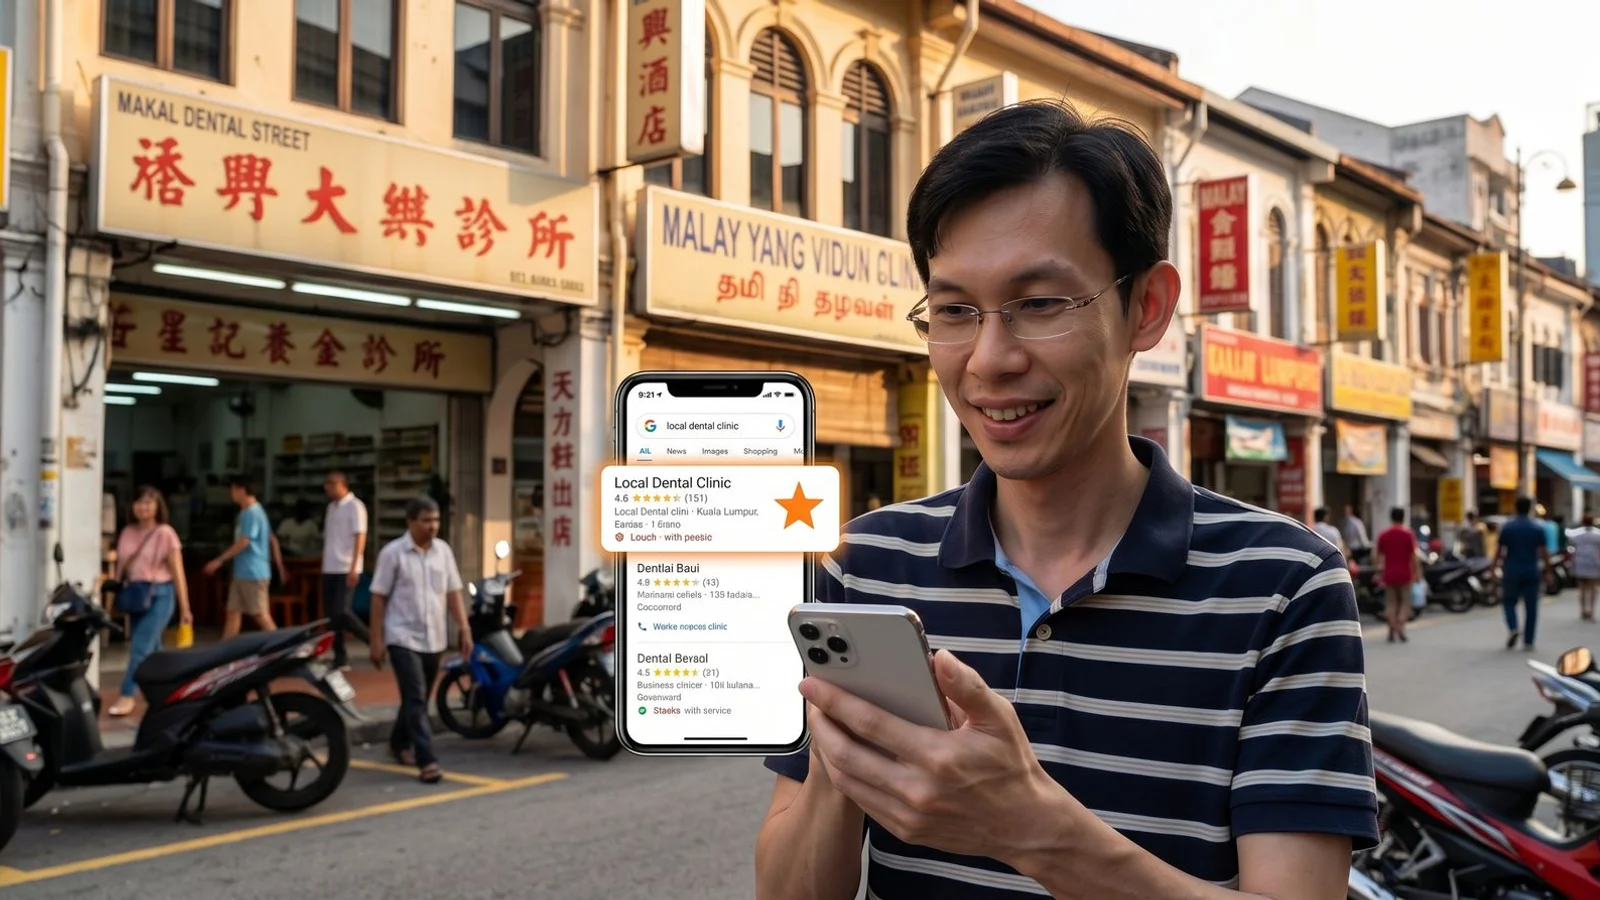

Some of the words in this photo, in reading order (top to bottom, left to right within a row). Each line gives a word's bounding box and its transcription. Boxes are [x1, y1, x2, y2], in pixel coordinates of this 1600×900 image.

[118, 91, 178, 125] MAKAL
[184, 105, 247, 140] DENTAL
[252, 120, 311, 152] STREET
[662, 204, 742, 259] MALAY
[748, 222, 805, 270] YANG
[811, 235, 870, 283] VIDUN
[638, 391, 655, 399] 9:21
[666, 421, 687, 430] local
[689, 421, 715, 430] dental
[717, 421, 739, 430] clinic
[702, 448, 729, 457] Images
[743, 447, 778, 458] Shopping
[614, 477, 649, 489] Local
[652, 477, 693, 489] Dental
[696, 477, 732, 489] Clinic
[614, 494, 629, 503] 4.6
[684, 493, 708, 505] (151)
[614, 507, 638, 516] Local
[641, 507, 668, 516] Dental
[671, 507, 689, 516] clini
[697, 507, 721, 516] Kuala
[630, 533, 657, 542] Louch
[664, 533, 682, 541] with
[707, 623, 728, 631] clinic
[637, 653, 672, 664] Dental
[637, 669, 650, 677] 4.5
[637, 681, 674, 689] Business
[684, 706, 701, 715] with
[703, 707, 732, 715] service
